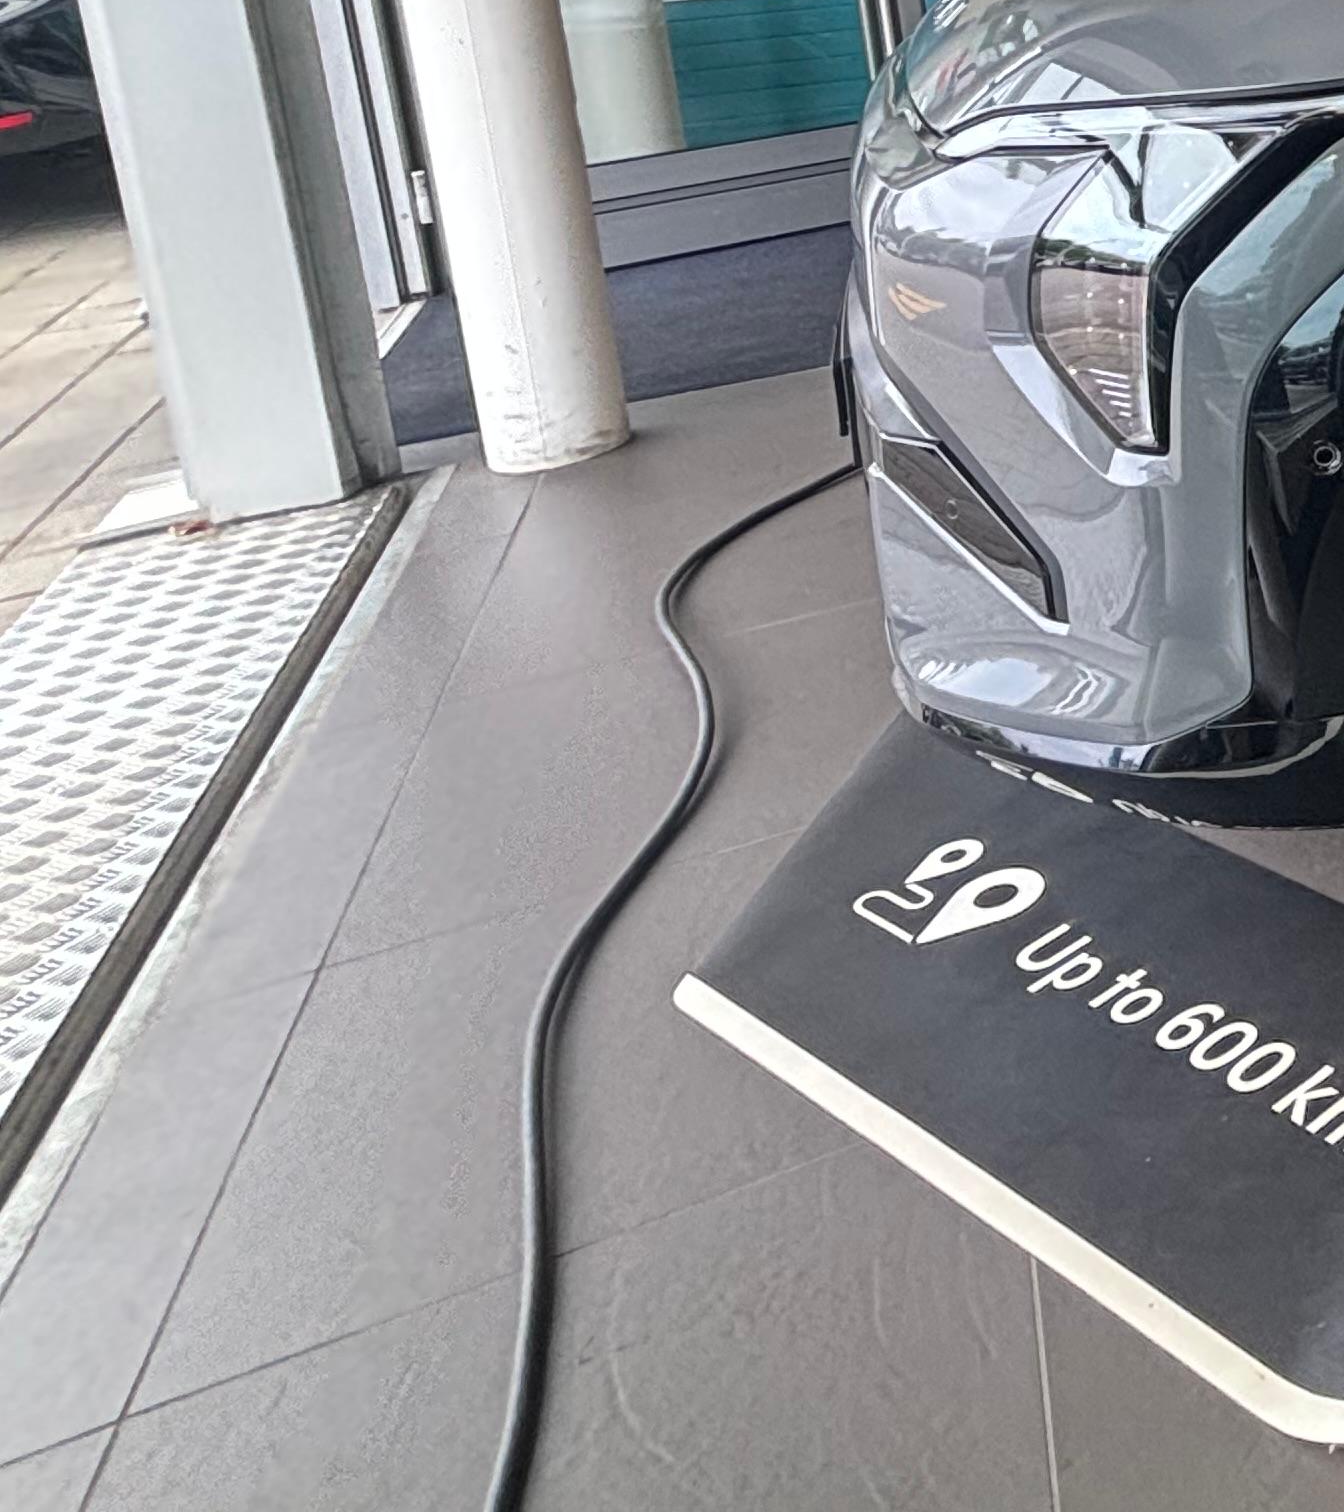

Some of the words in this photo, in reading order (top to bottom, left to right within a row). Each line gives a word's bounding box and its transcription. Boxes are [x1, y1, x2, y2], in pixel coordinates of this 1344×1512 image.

[1015, 923, 1103, 994] Up
[1087, 968, 1164, 1024] to
[1154, 1003, 1297, 1093] 600
